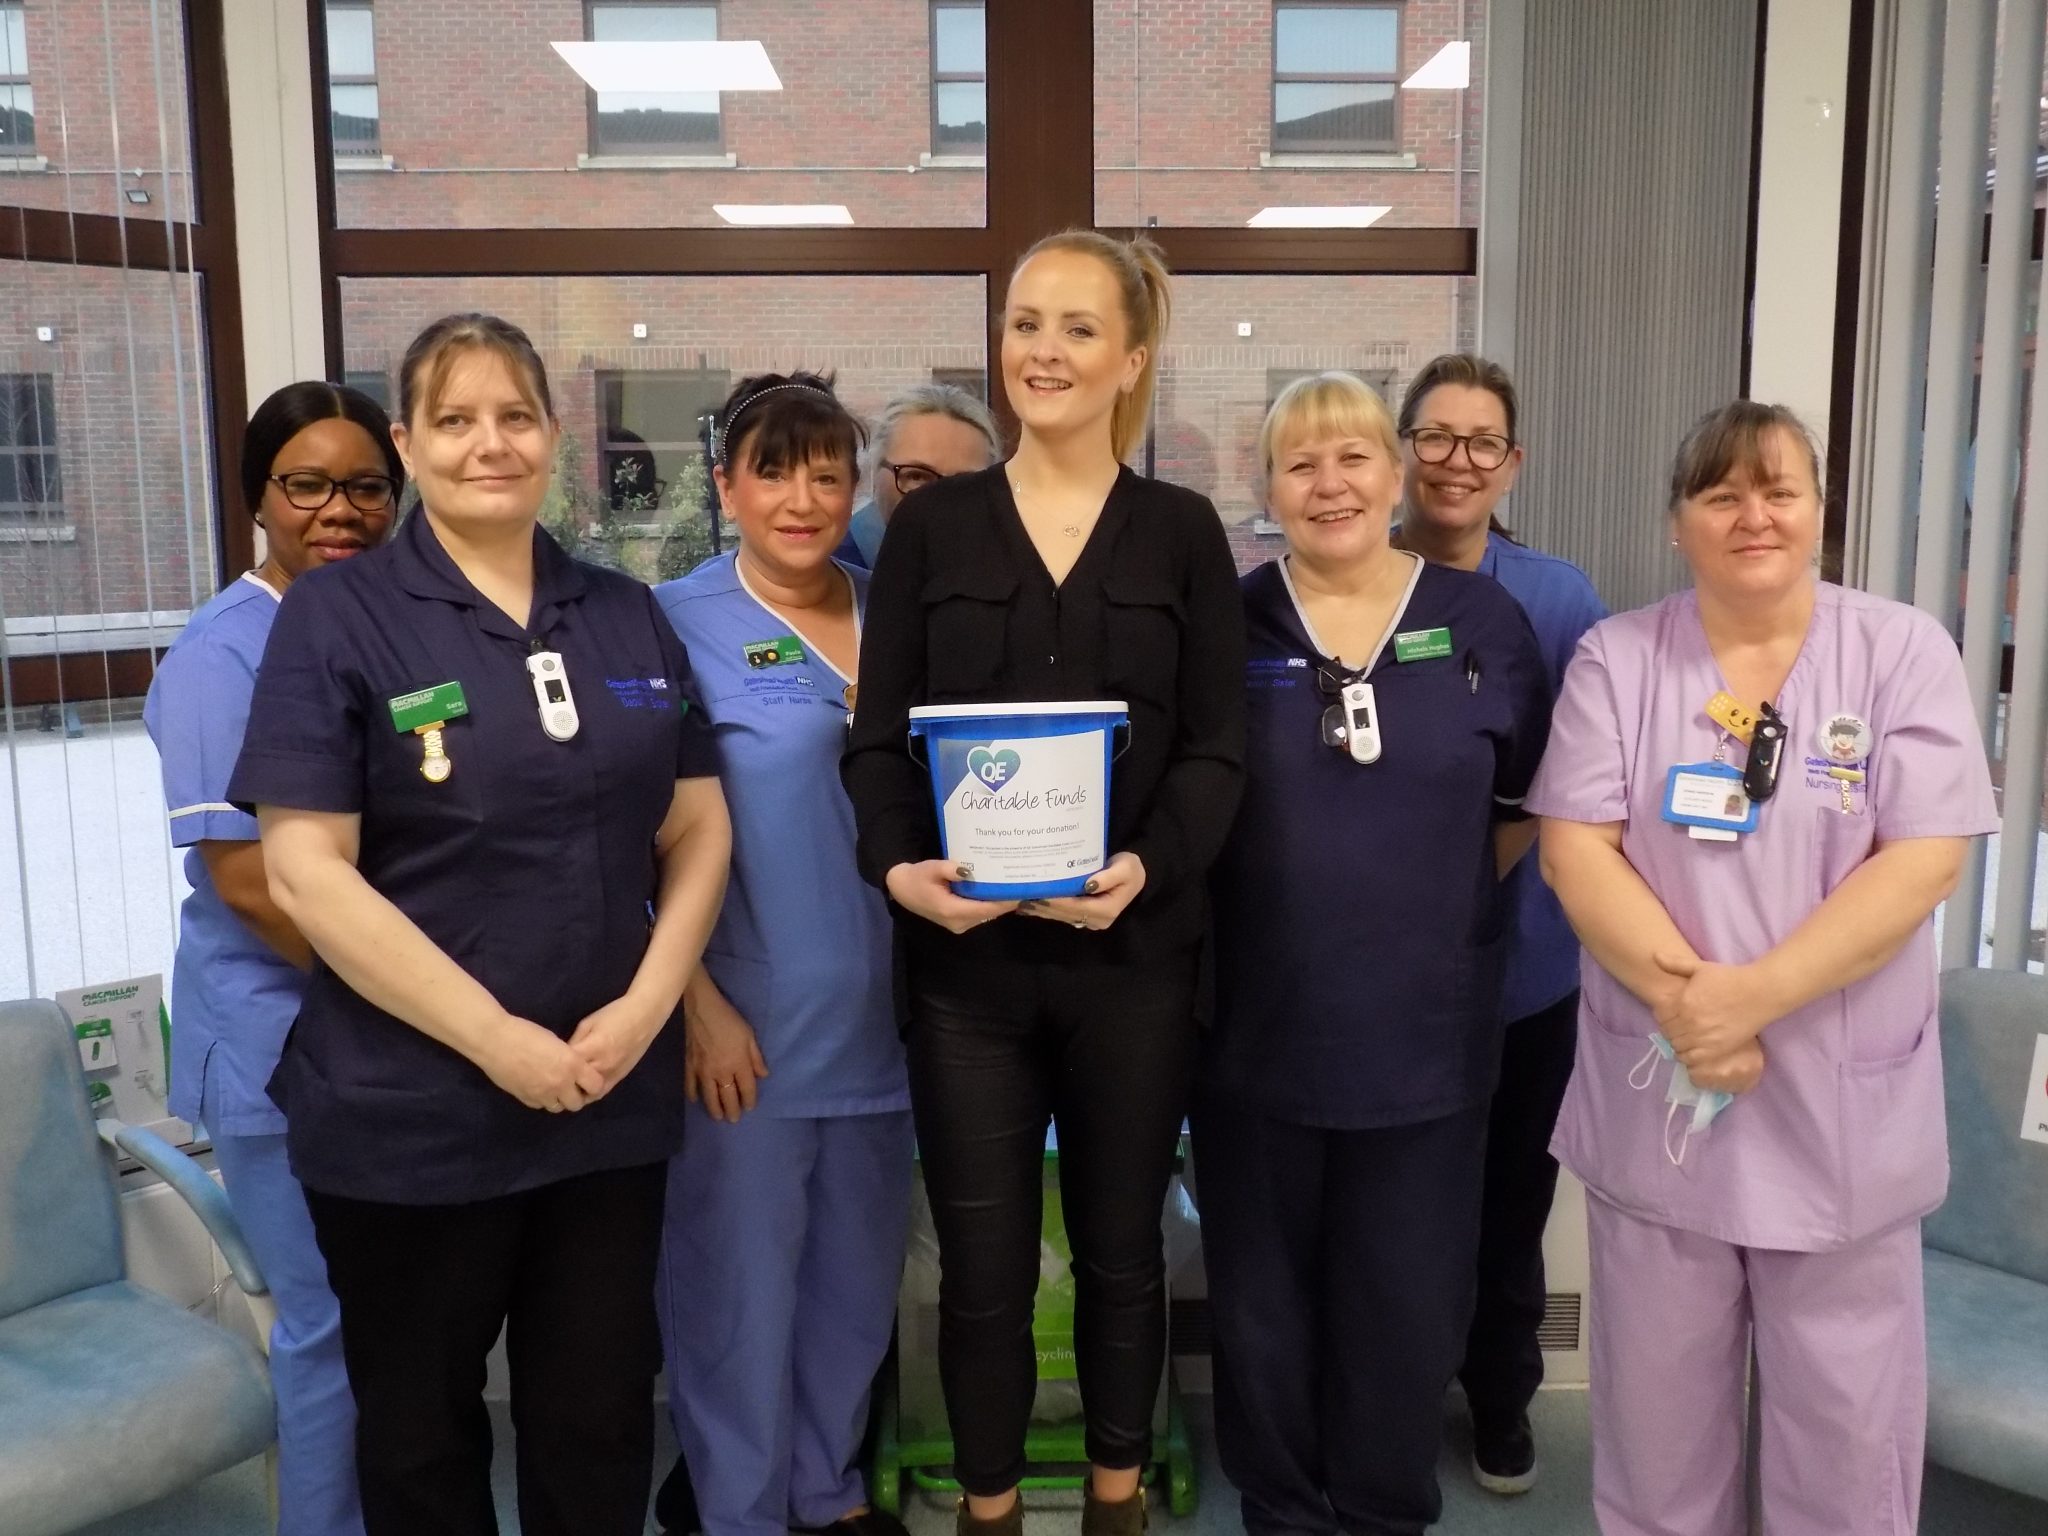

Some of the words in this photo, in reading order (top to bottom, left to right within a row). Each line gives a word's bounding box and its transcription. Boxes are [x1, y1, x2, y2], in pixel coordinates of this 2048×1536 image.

[1286, 658, 1308, 667] NHS
[649, 678, 668, 689] NHS
[391, 691, 435, 709] MACMILLAN
[762, 696, 784, 706] Staff
[789, 696, 812, 705] Nurse
[981, 761, 1007, 784] QE
[961, 790, 1040, 811] Charitable
[1045, 785, 1087, 808] Funds
[975, 827, 997, 837] Thank
[997, 829, 1012, 837] you
[1013, 828, 1025, 836] for
[1026, 828, 1044, 837] your
[1046, 823, 1080, 834] donation!
[1066, 859, 1076, 869] QE
[82, 985, 139, 1002] MACMILLAN
[83, 998, 108, 1007] CANCER
[108, 992, 136, 1002] SUPPORT
[1036, 1346, 1076, 1365] cyclin
